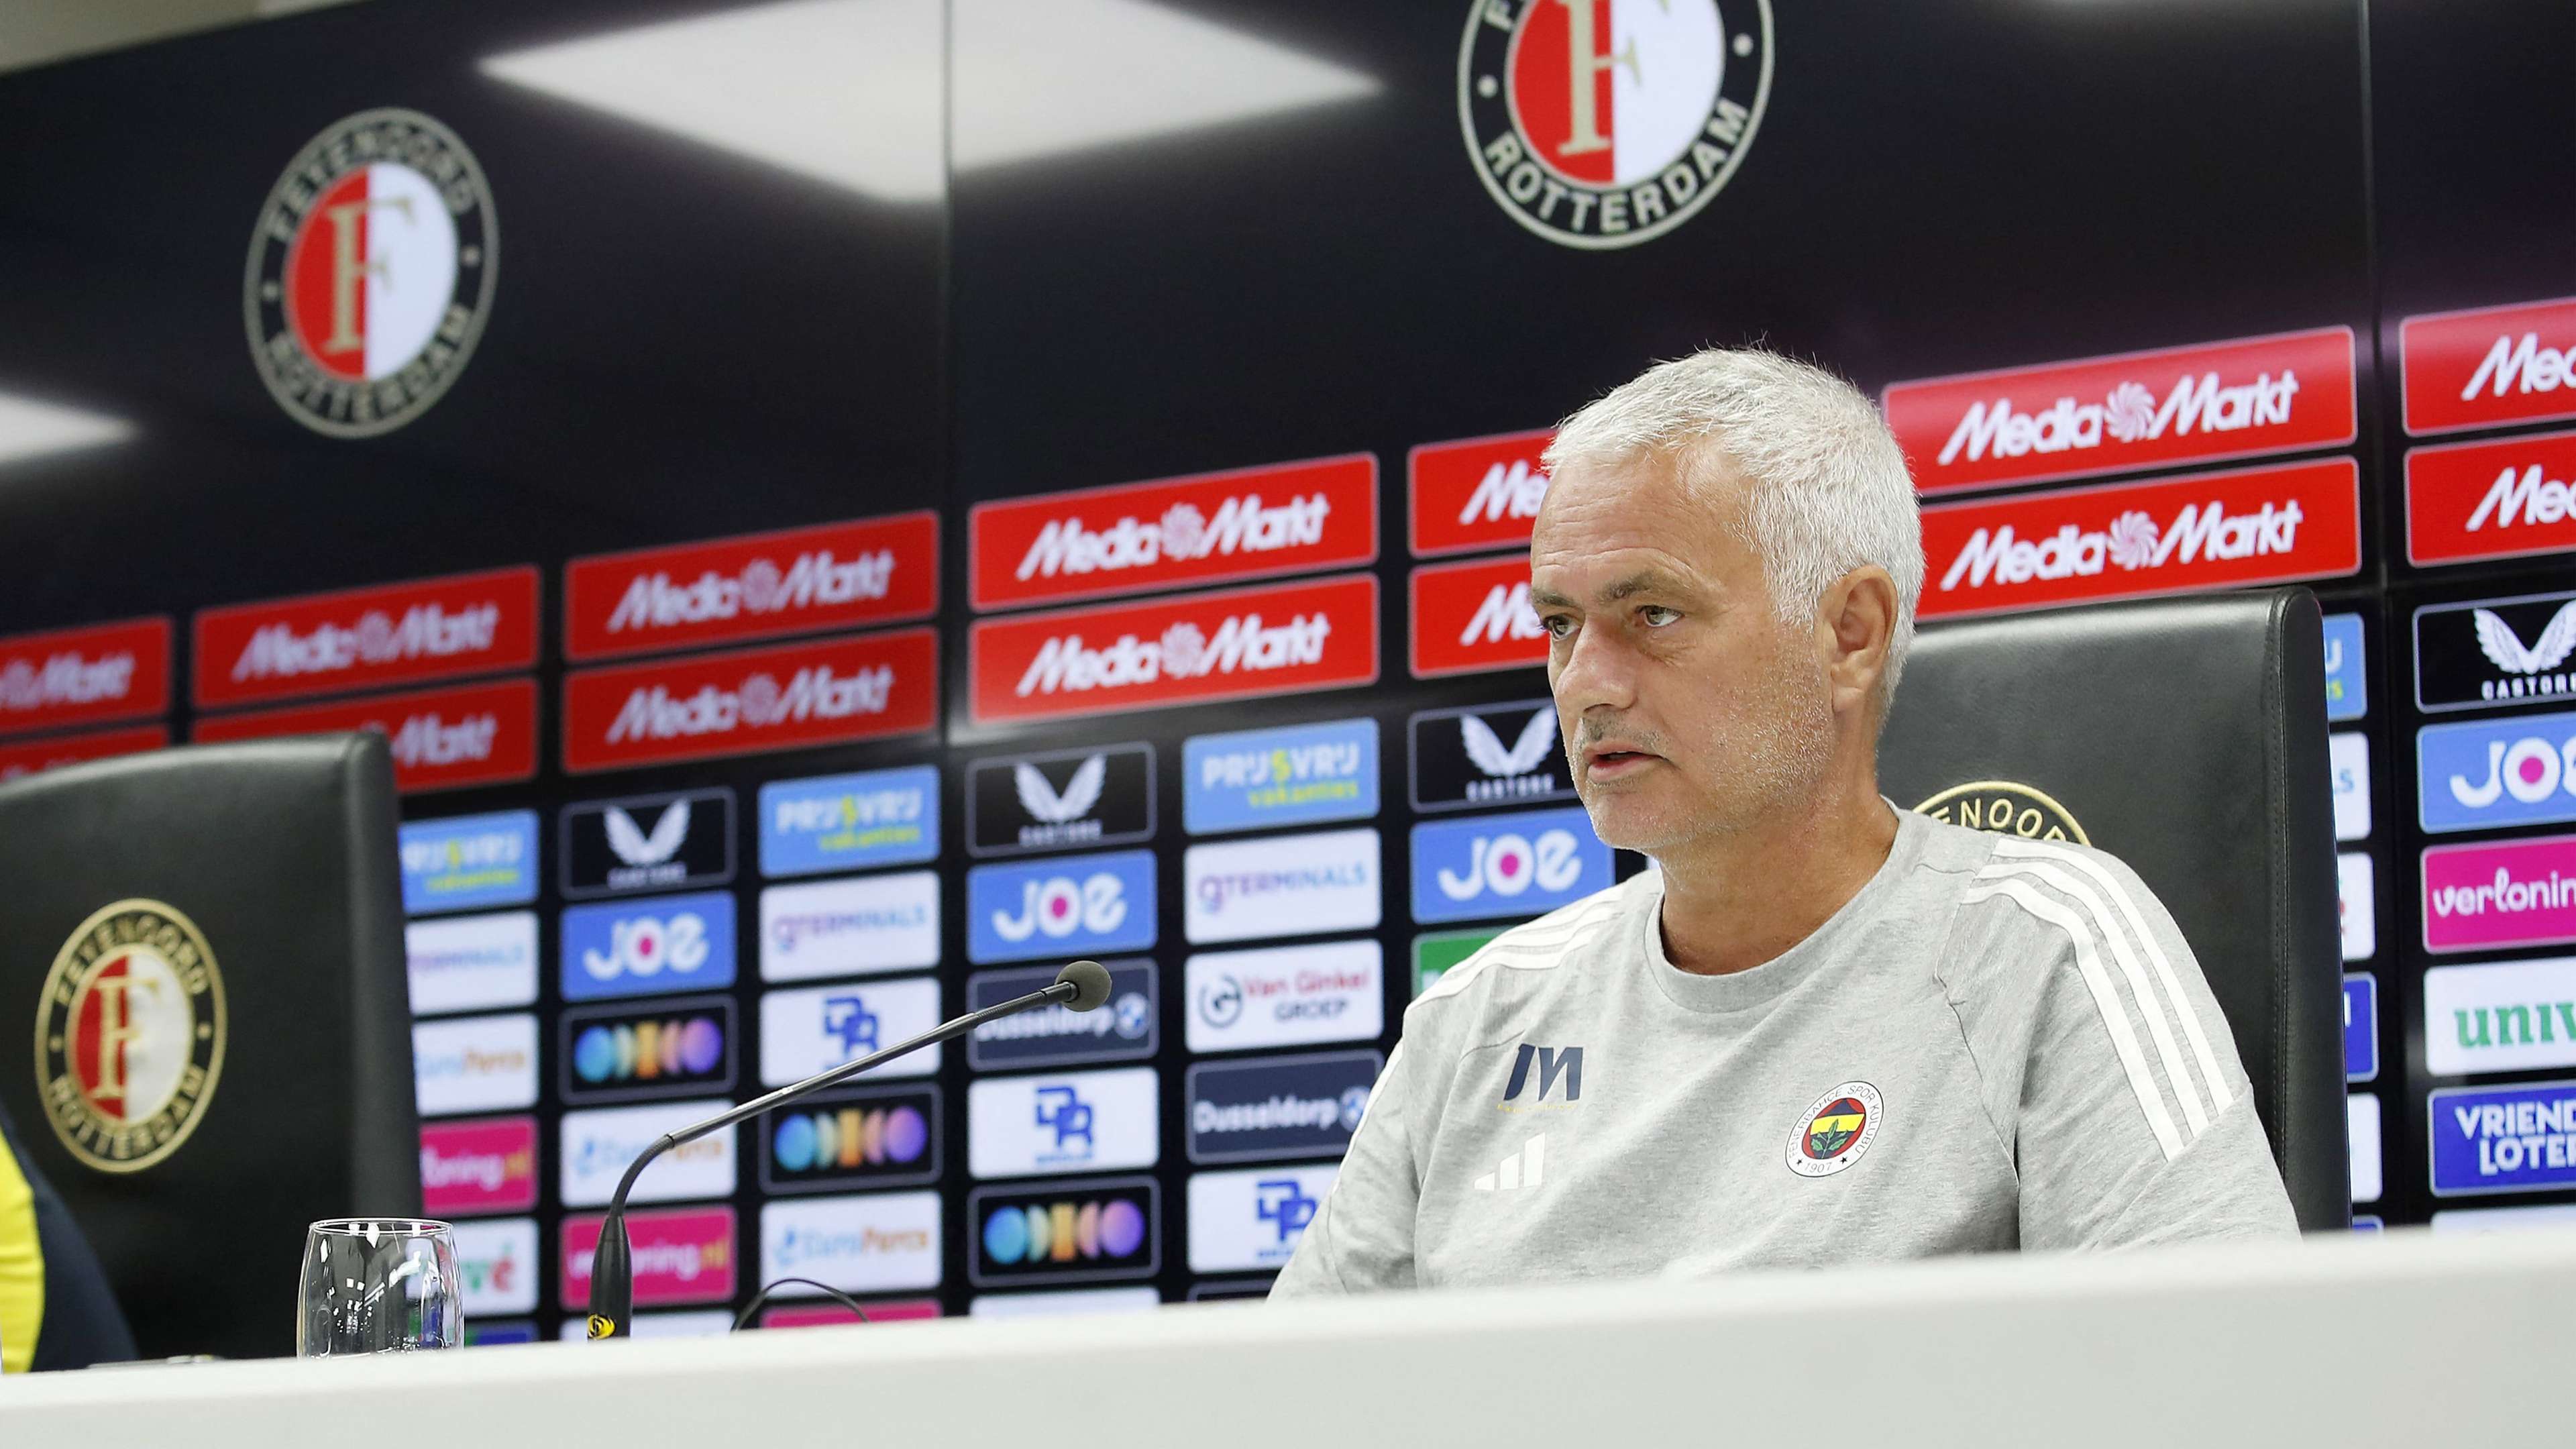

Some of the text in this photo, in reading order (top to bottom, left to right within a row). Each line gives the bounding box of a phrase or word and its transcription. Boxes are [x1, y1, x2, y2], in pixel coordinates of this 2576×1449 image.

[1483, 97, 1750, 235] ROTTERDAM
[2449, 737, 2576, 808] JO
[1847, 1085, 1876, 1104] SPOR
[1805, 1162, 1833, 1173] 1907
